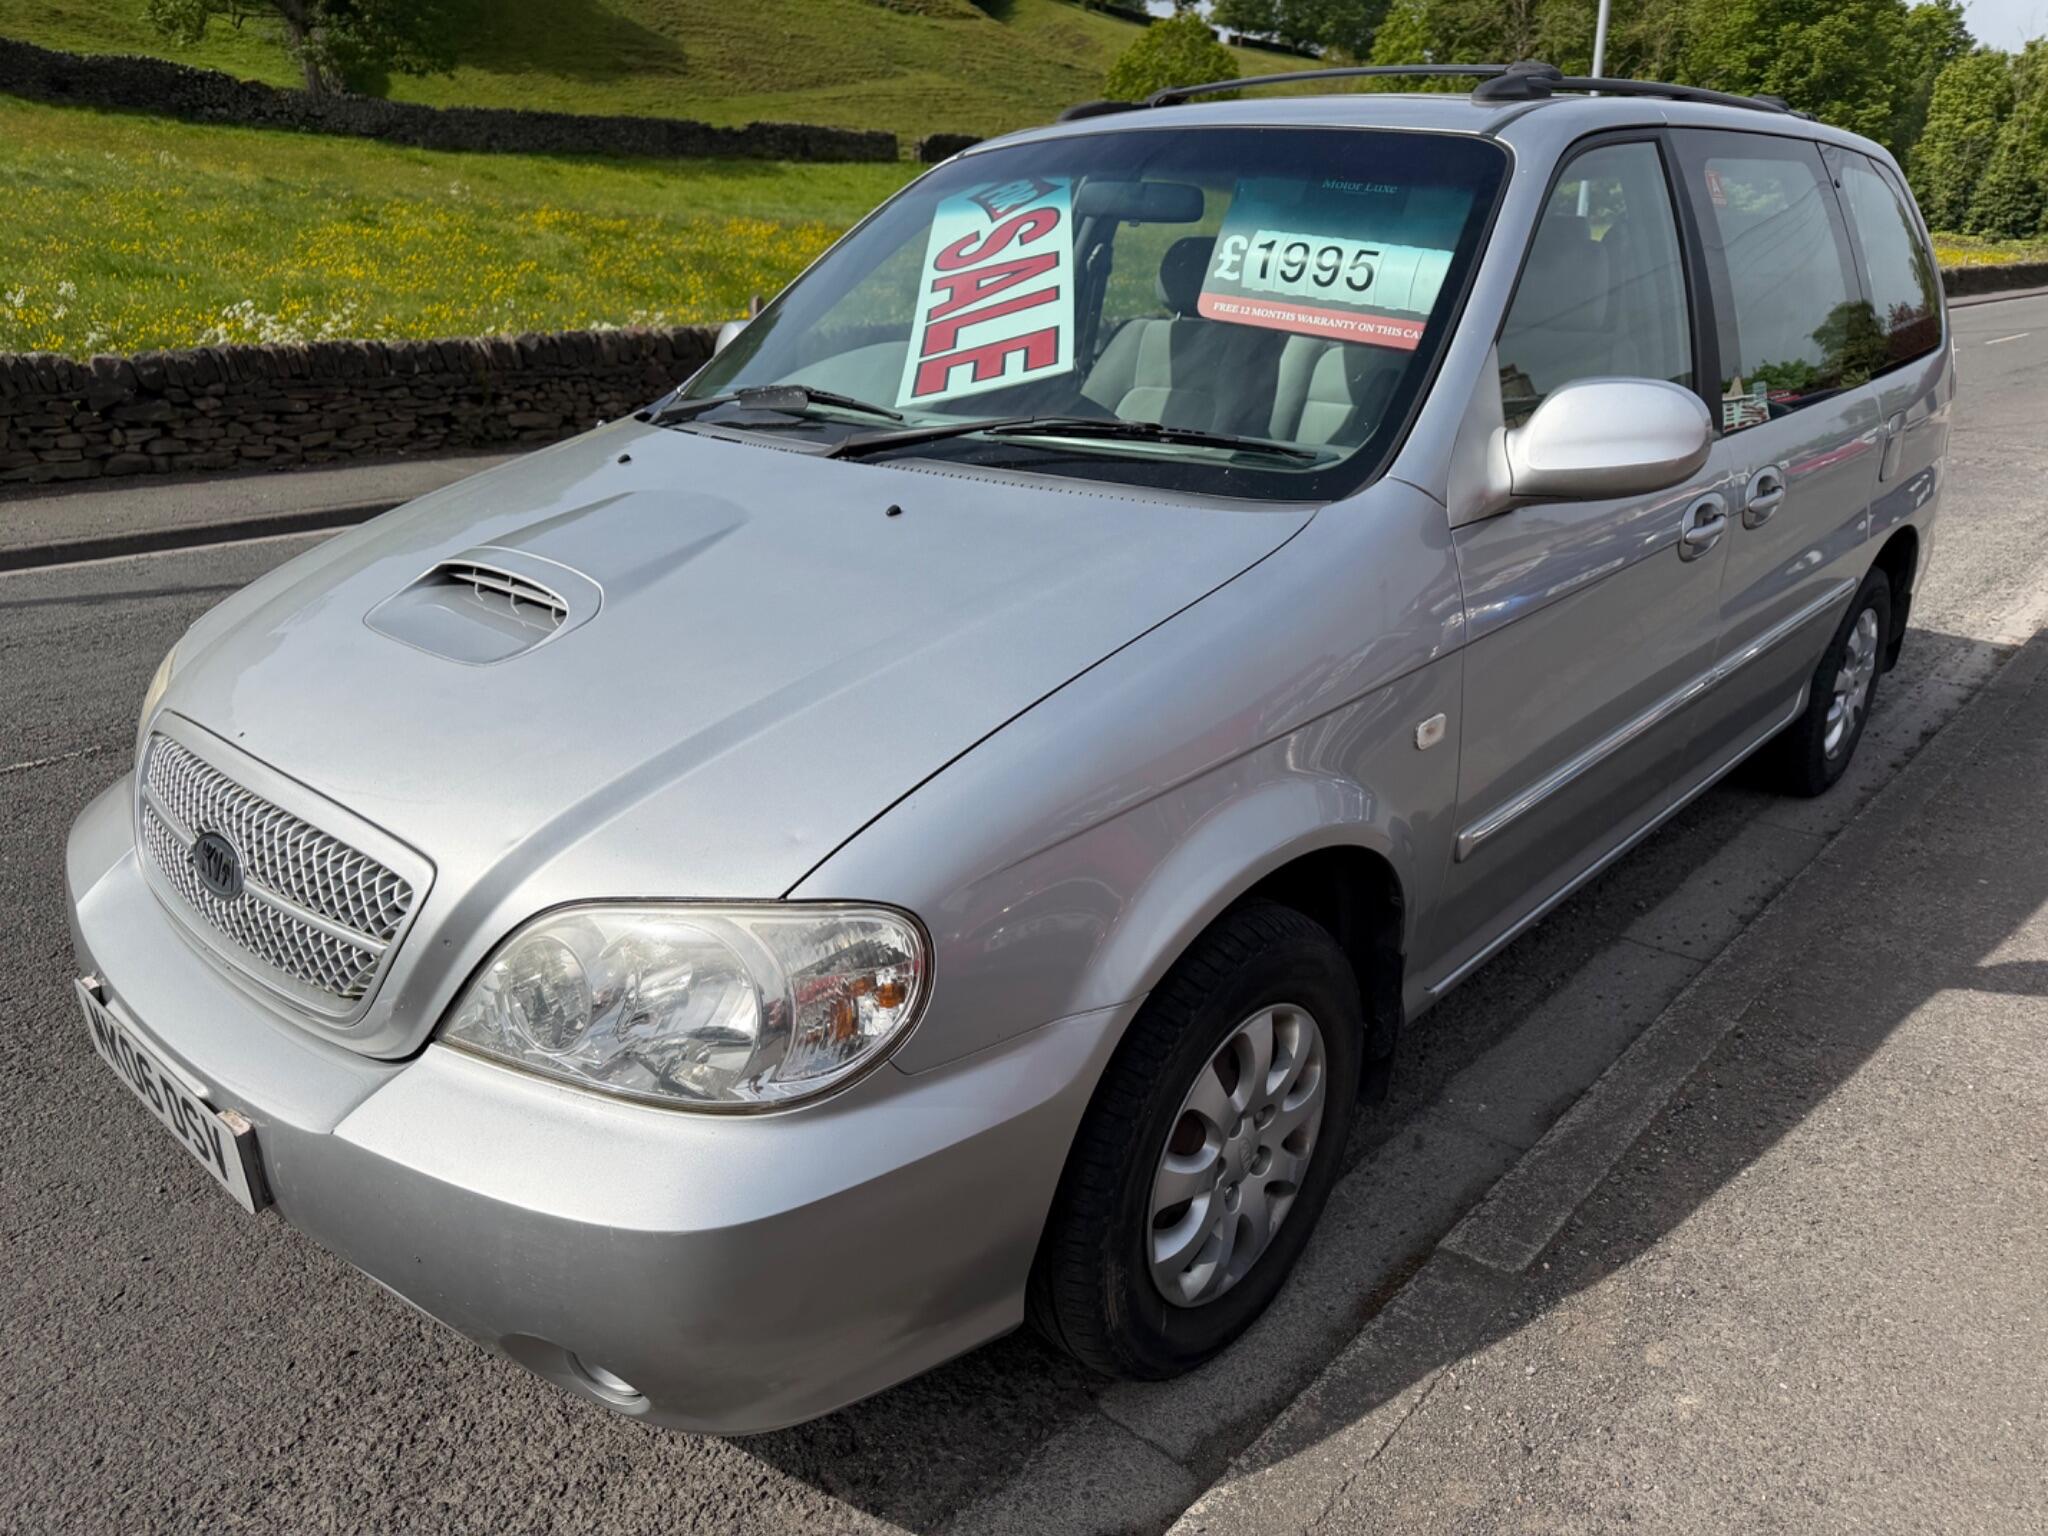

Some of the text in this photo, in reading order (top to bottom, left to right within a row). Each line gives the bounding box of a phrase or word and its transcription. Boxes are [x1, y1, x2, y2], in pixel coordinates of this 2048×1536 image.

[1322, 179, 1398, 193] Motor Luxe
[1213, 234, 1381, 292] £1995
[910, 206, 1061, 399] SALE
[1213, 302, 1239, 313] FREE
[1240, 305, 1250, 315] 12
[1251, 308, 1296, 321] MONTHS
[1297, 313, 1358, 331] WARRANTY
[1357, 322, 1374, 333] ON
[1375, 325, 1402, 337] THIS
[159, 1073, 229, 1182] DSV
